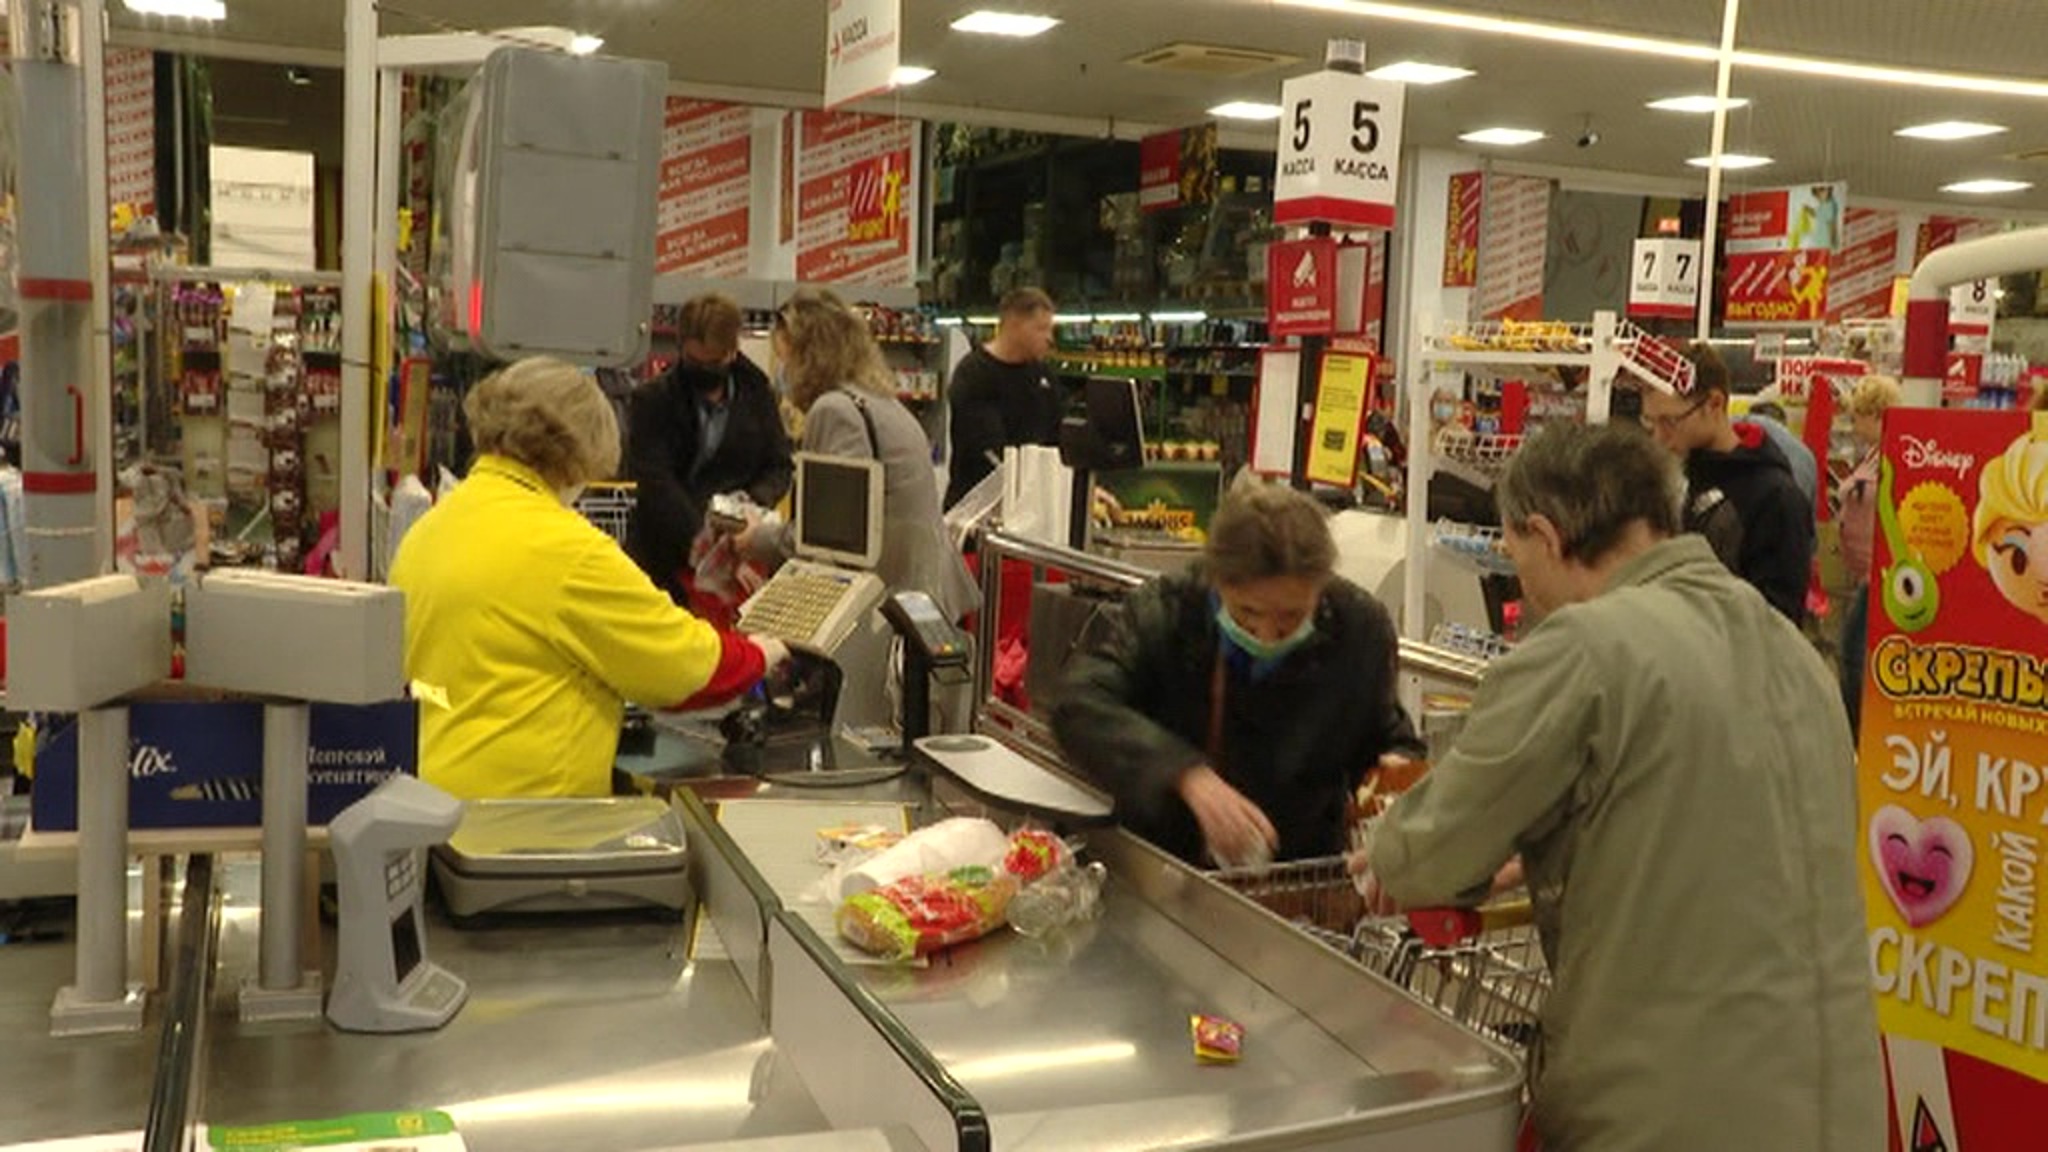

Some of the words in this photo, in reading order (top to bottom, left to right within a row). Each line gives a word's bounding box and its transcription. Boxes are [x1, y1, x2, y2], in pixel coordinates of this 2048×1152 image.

[1293, 99, 1312, 152] 5
[1351, 100, 1379, 153] 5
[1283, 157, 1315, 176] КАССА
[1335, 157, 1389, 181] КАССА
[1643, 251, 1656, 279] 7
[1677, 253, 1691, 281] 7
[1973, 279, 1986, 302] 8
[1899, 435, 1974, 480] Disney
[1893, 702, 1978, 722] ВСТРЕЧАЙ
[1981, 708, 2047, 735] НОВЫХ
[1881, 730, 1959, 808] ЭЙ,
[1992, 831, 2038, 953] КАКОЙ
